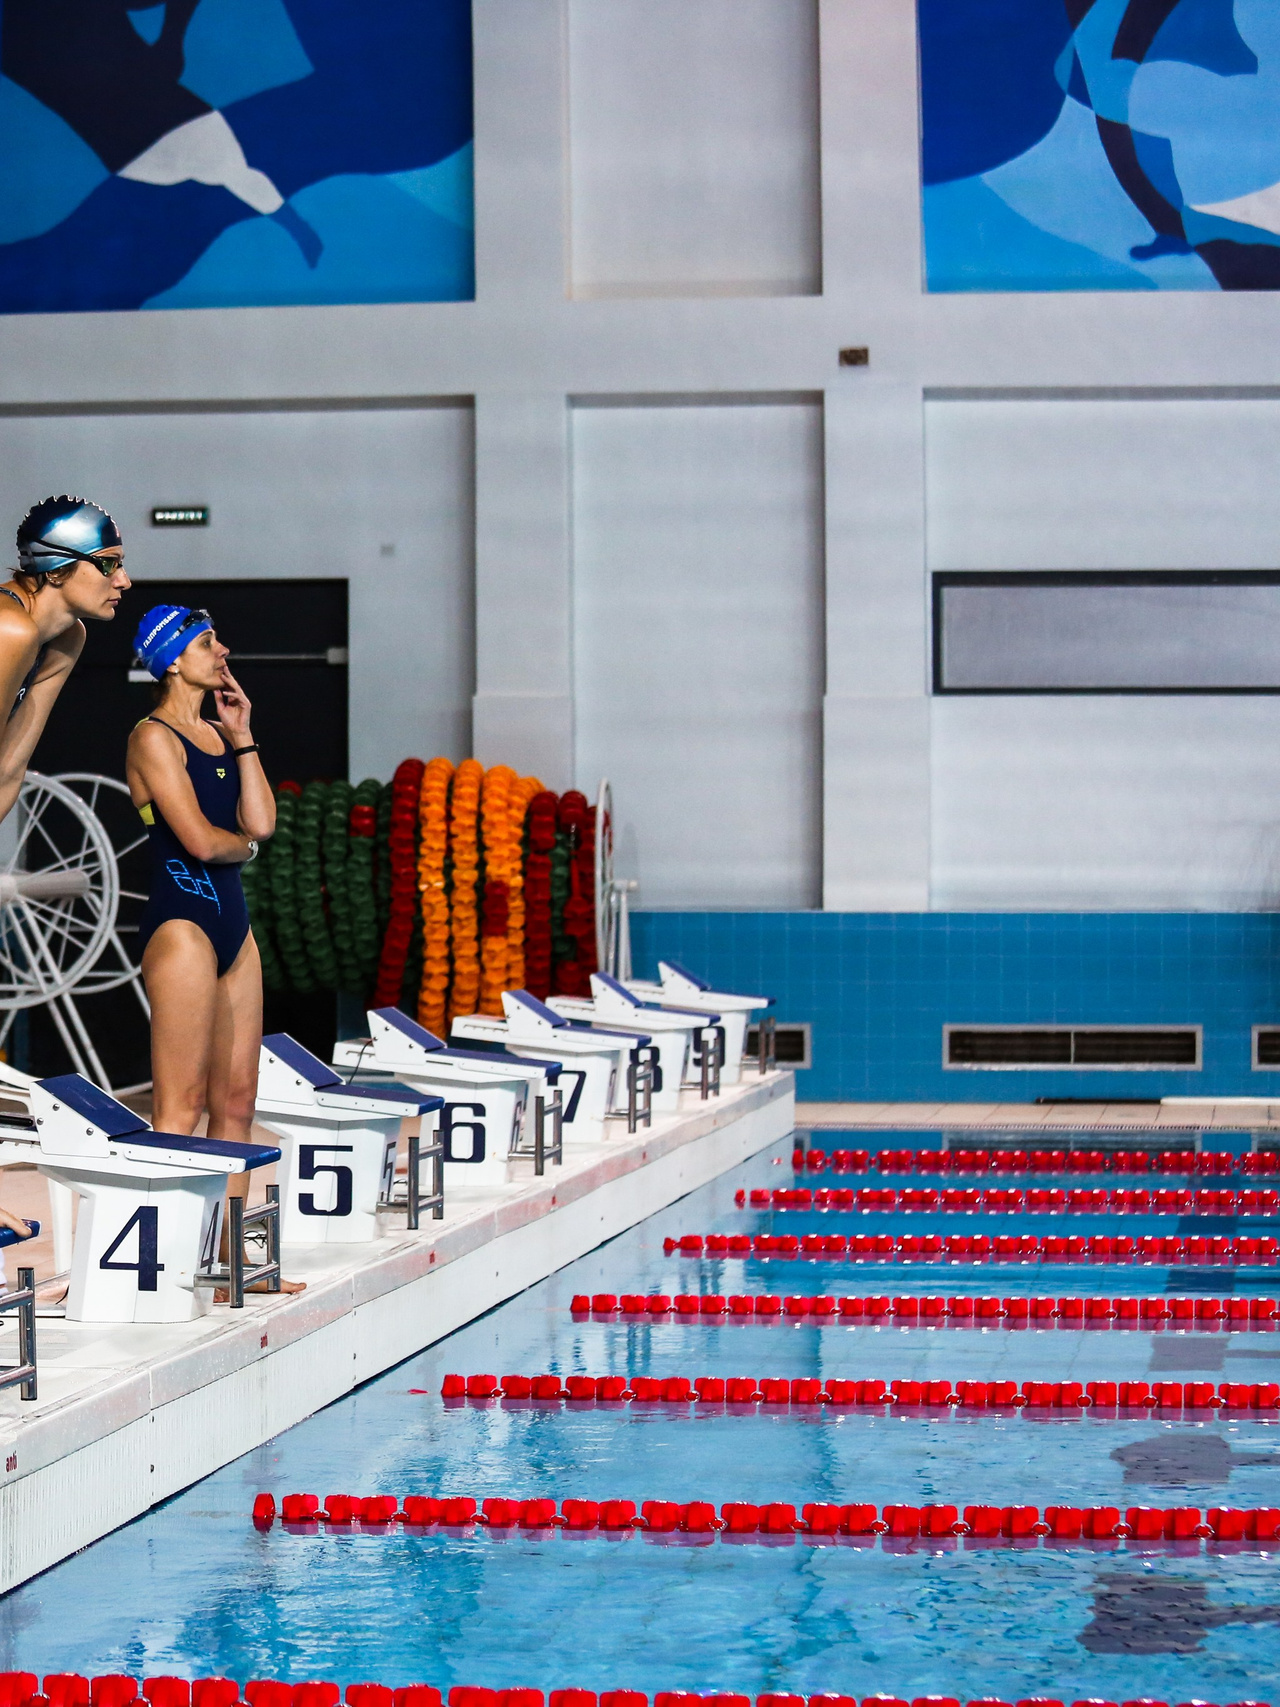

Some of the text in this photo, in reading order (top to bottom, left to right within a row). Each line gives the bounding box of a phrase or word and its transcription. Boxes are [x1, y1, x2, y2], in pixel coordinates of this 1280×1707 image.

[627, 1046, 663, 1092] 8
[693, 1026, 725, 1068] 9
[547, 1070, 587, 1123] 7
[439, 1102, 486, 1163] 6
[298, 1144, 353, 1216] 5
[99, 1206, 164, 1292] 4
